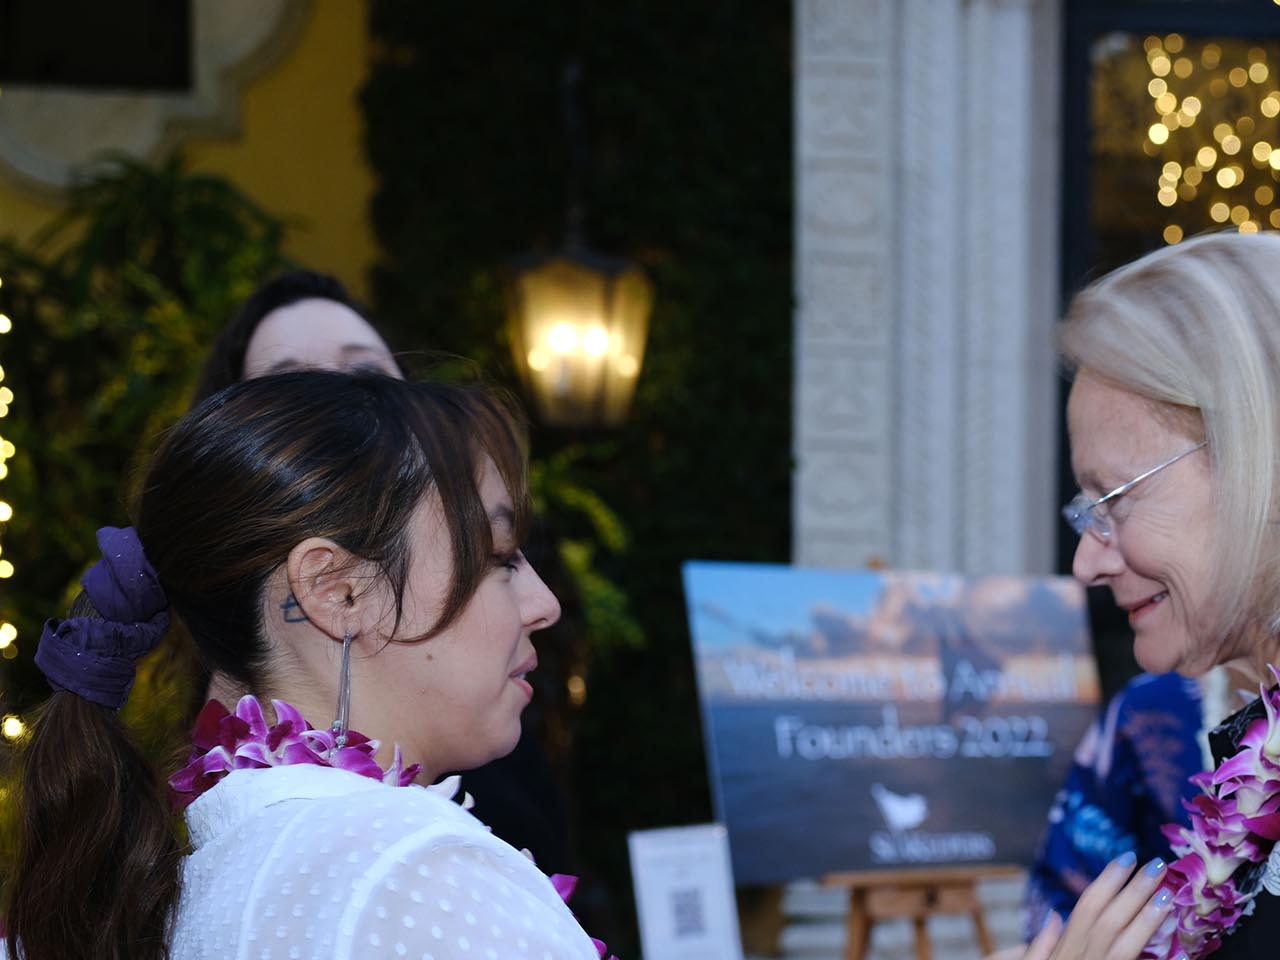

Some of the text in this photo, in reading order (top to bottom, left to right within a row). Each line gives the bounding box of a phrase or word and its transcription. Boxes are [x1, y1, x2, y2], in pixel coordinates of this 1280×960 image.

[724, 647, 896, 699] Welcome
[774, 704, 1054, 760] Founders 2022
